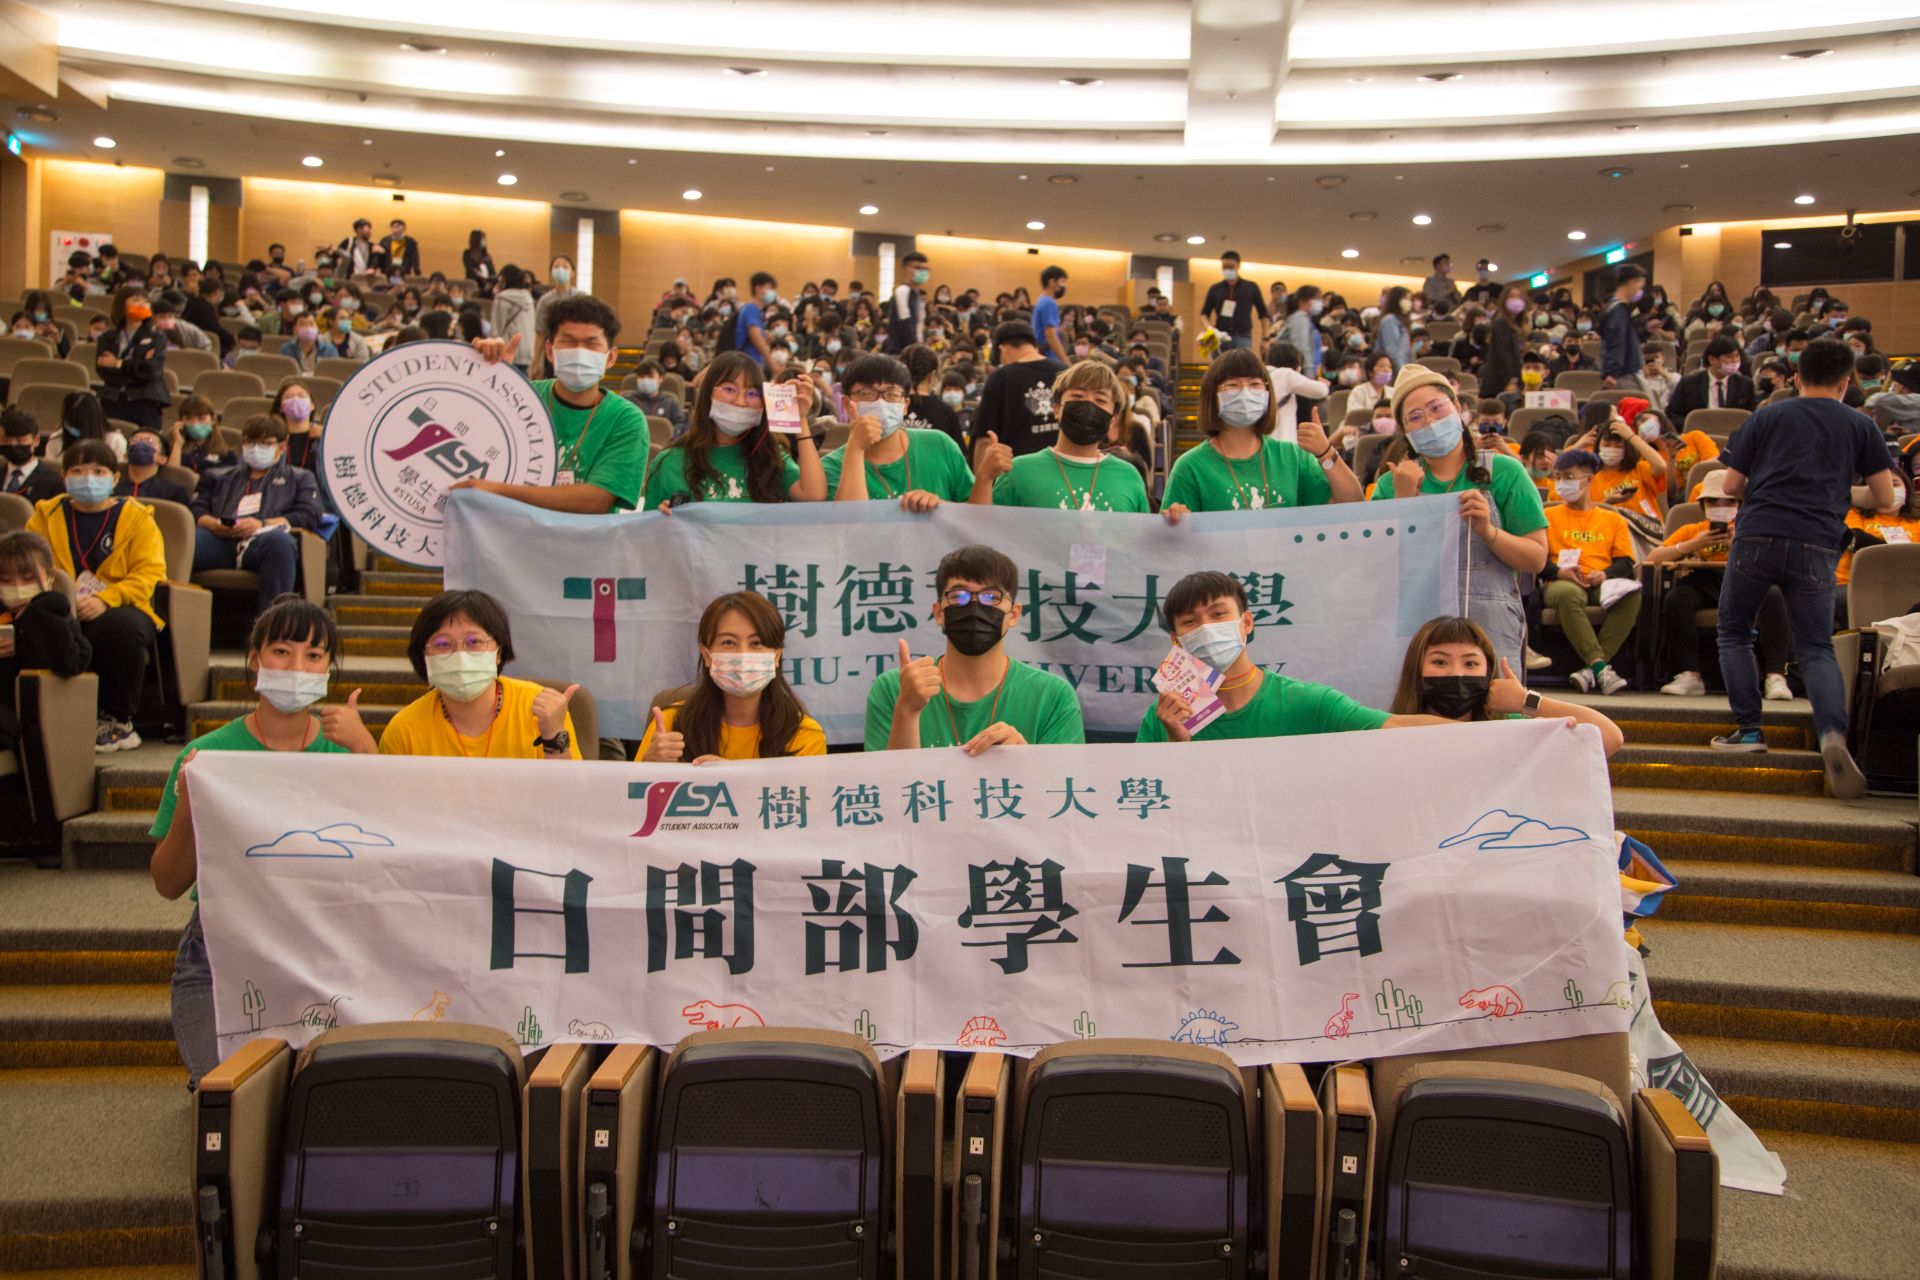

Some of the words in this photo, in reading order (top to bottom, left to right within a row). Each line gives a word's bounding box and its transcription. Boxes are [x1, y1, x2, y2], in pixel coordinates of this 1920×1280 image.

[358, 354, 481, 406] STUDENT
[482, 374, 545, 487] ASSOCIATI
[333, 456, 438, 557] 樹德科技大
[393, 486, 427, 515] #STUSA
[737, 562, 1295, 646] 樹德技大學
[782, 653, 927, 686] HU-T
[660, 823, 691, 831] STUDENT
[693, 822, 740, 831] ASSOCIATION
[757, 777, 1172, 831] 樹德科技大學
[490, 852, 1392, 976] 日間部學生會
